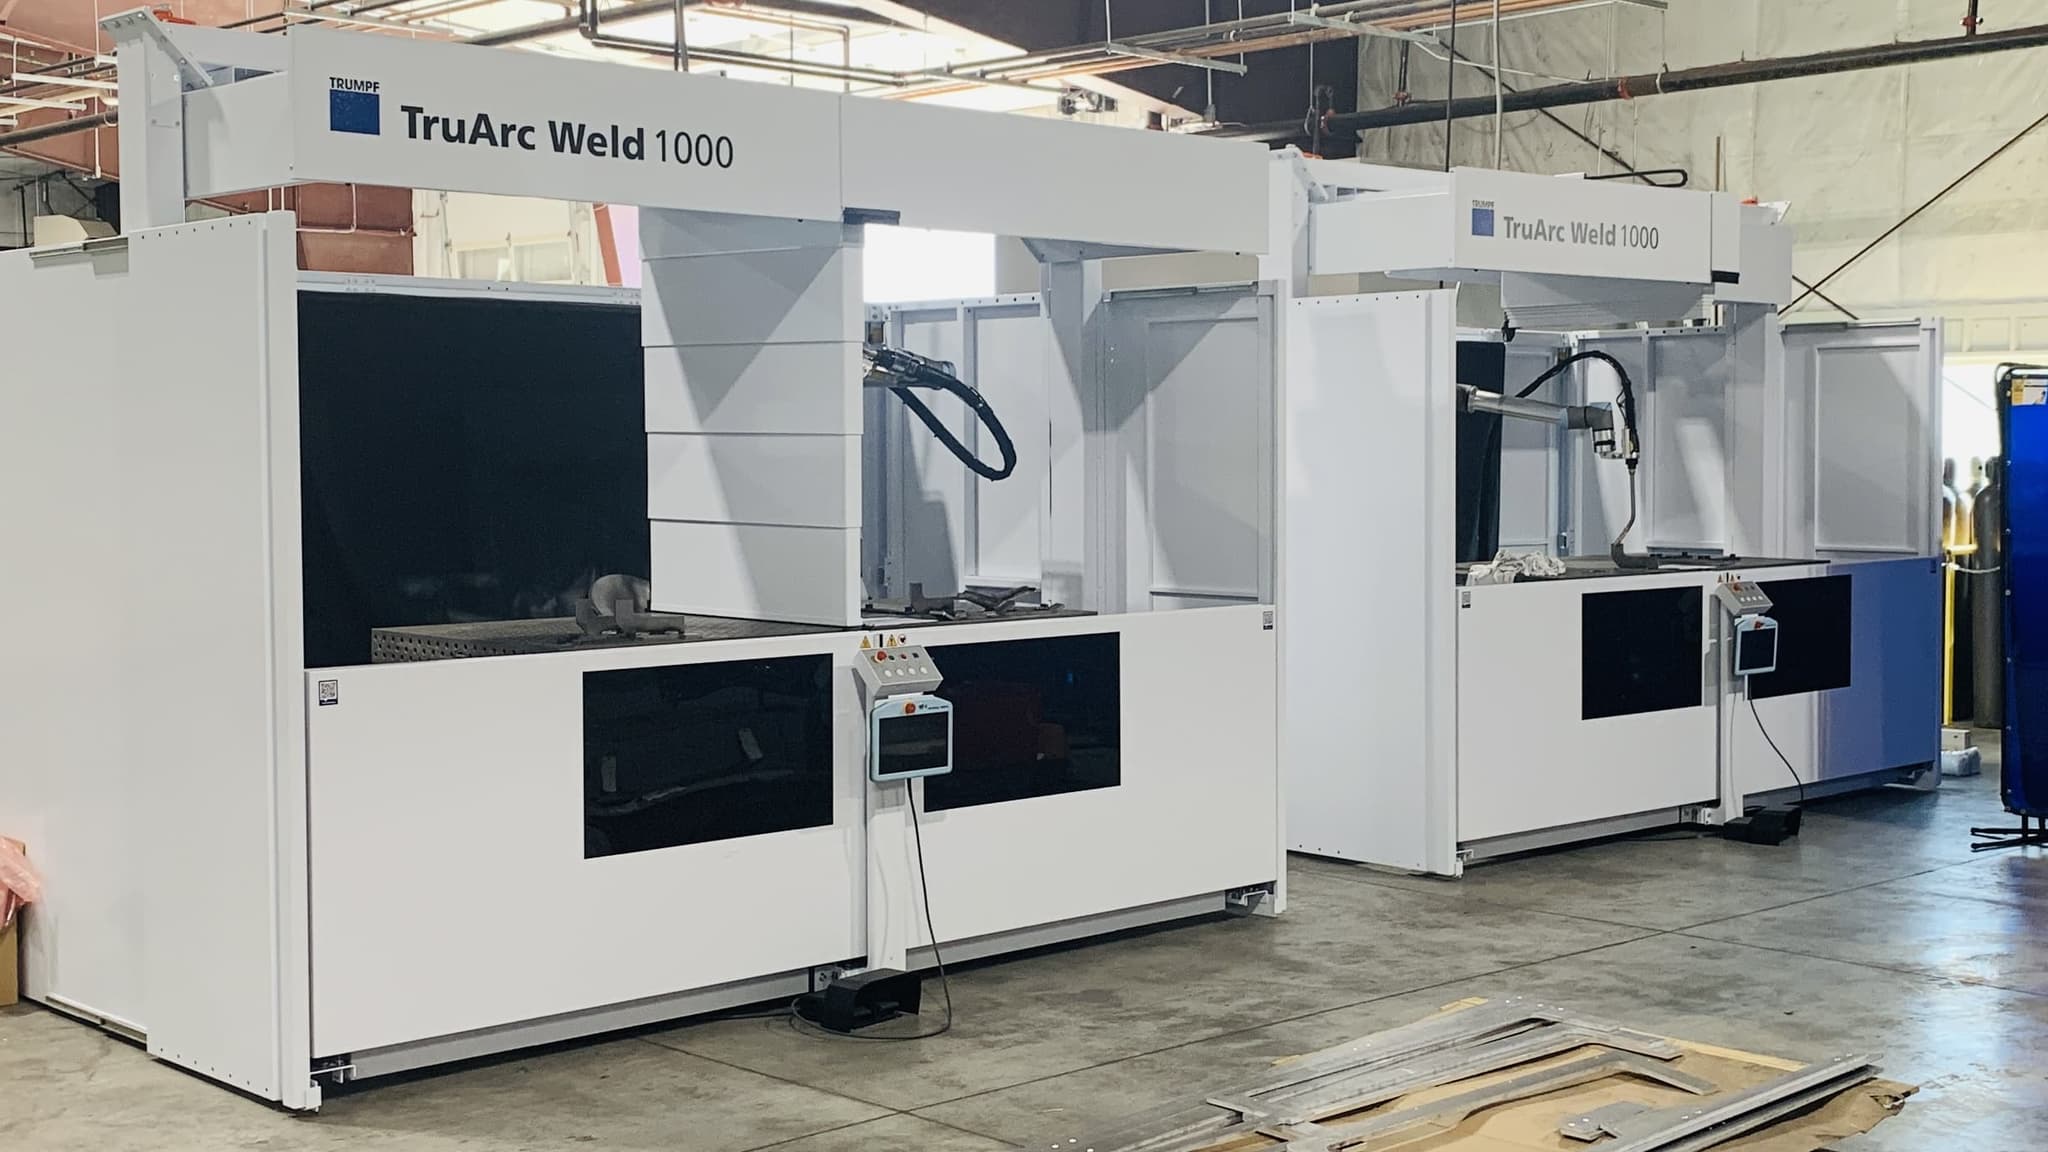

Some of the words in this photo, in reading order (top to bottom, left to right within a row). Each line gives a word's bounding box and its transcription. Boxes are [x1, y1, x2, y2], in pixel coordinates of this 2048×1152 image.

[329, 77, 380, 93] TRUMPF
[401, 105, 536, 150] TruArc
[548, 120, 645, 160] Weld
[655, 129, 734, 168] 1000
[1472, 199, 1495, 208] TRUMPF
[1504, 216, 1565, 243] TruArc
[1571, 221, 1616, 246] Weld
[1621, 225, 1659, 249] 1000
